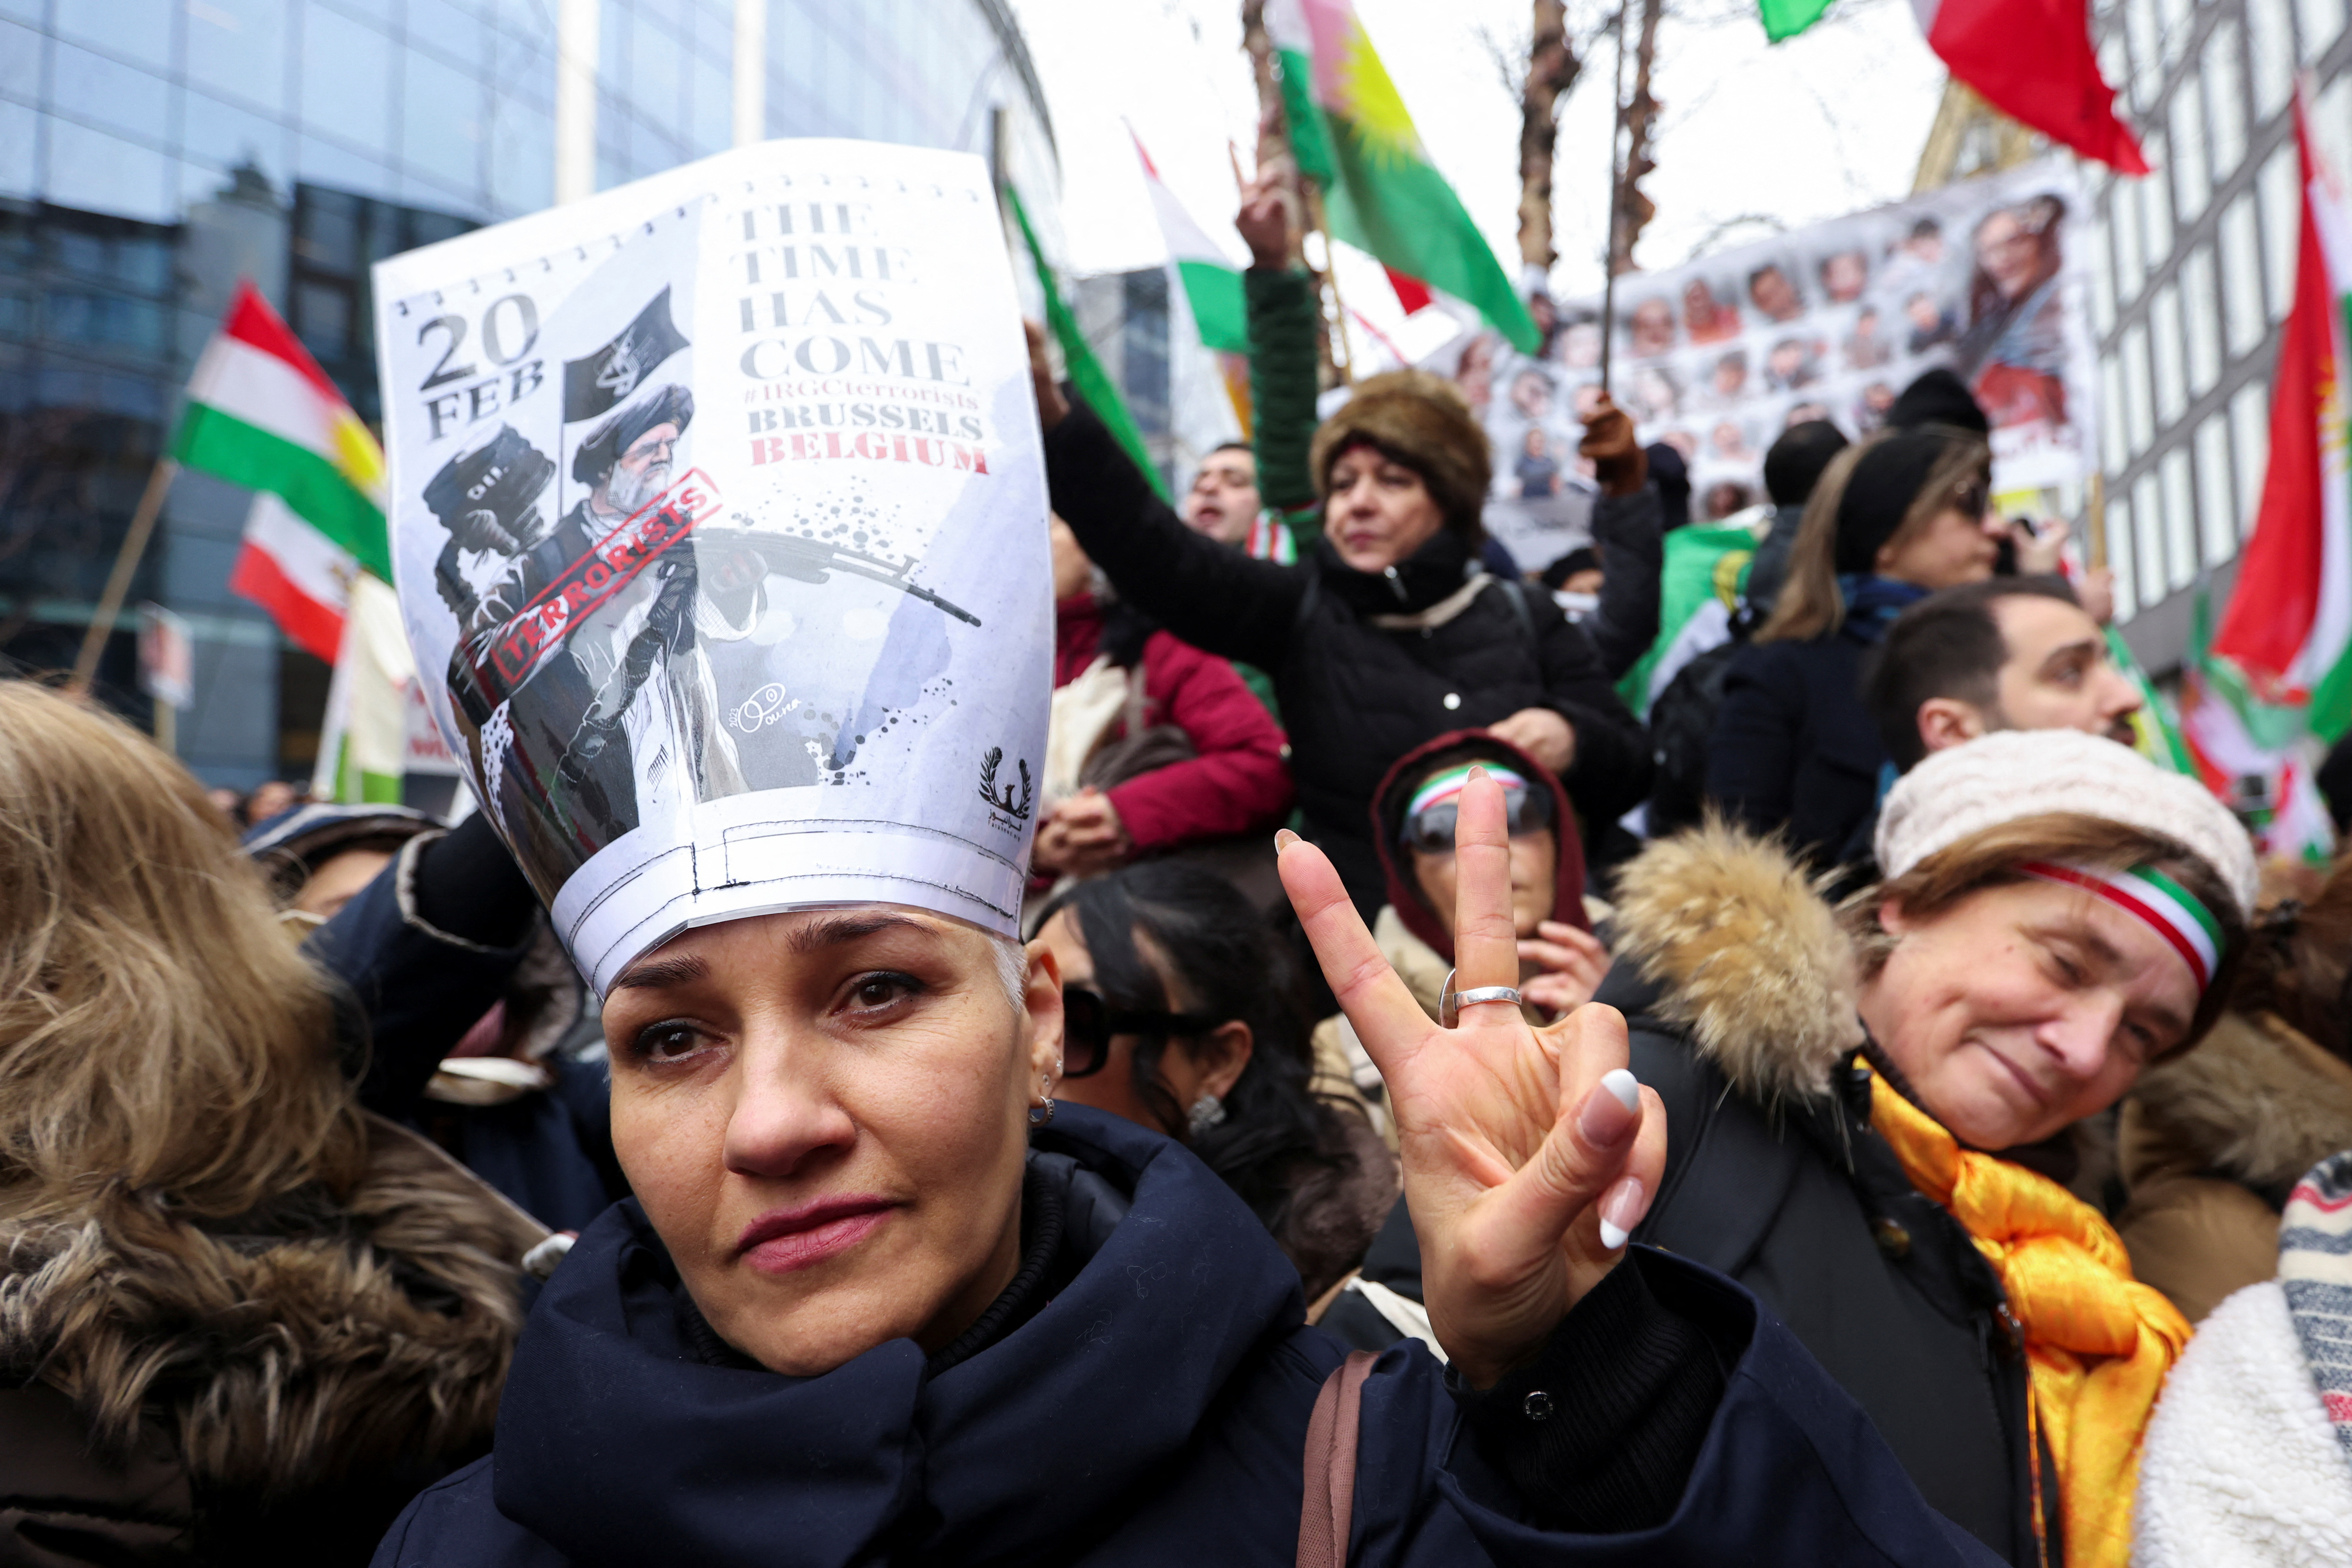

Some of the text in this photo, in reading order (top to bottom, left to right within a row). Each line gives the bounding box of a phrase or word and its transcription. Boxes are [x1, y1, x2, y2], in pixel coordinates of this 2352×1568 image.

[726, 202, 880, 241] THE
[728, 243, 919, 285] TIME
[735, 291, 892, 333] HAS
[417, 293, 540, 393] 20
[739, 335, 971, 387] COME
[423, 359, 543, 445] FEB
[743, 379, 980, 411] #IRGCterrorists
[747, 402, 984, 441] BRUSSELS
[749, 432, 990, 476] BELGIUM
[503, 486, 708, 662] TERRORISTS
[728, 708, 739, 728] 2023
